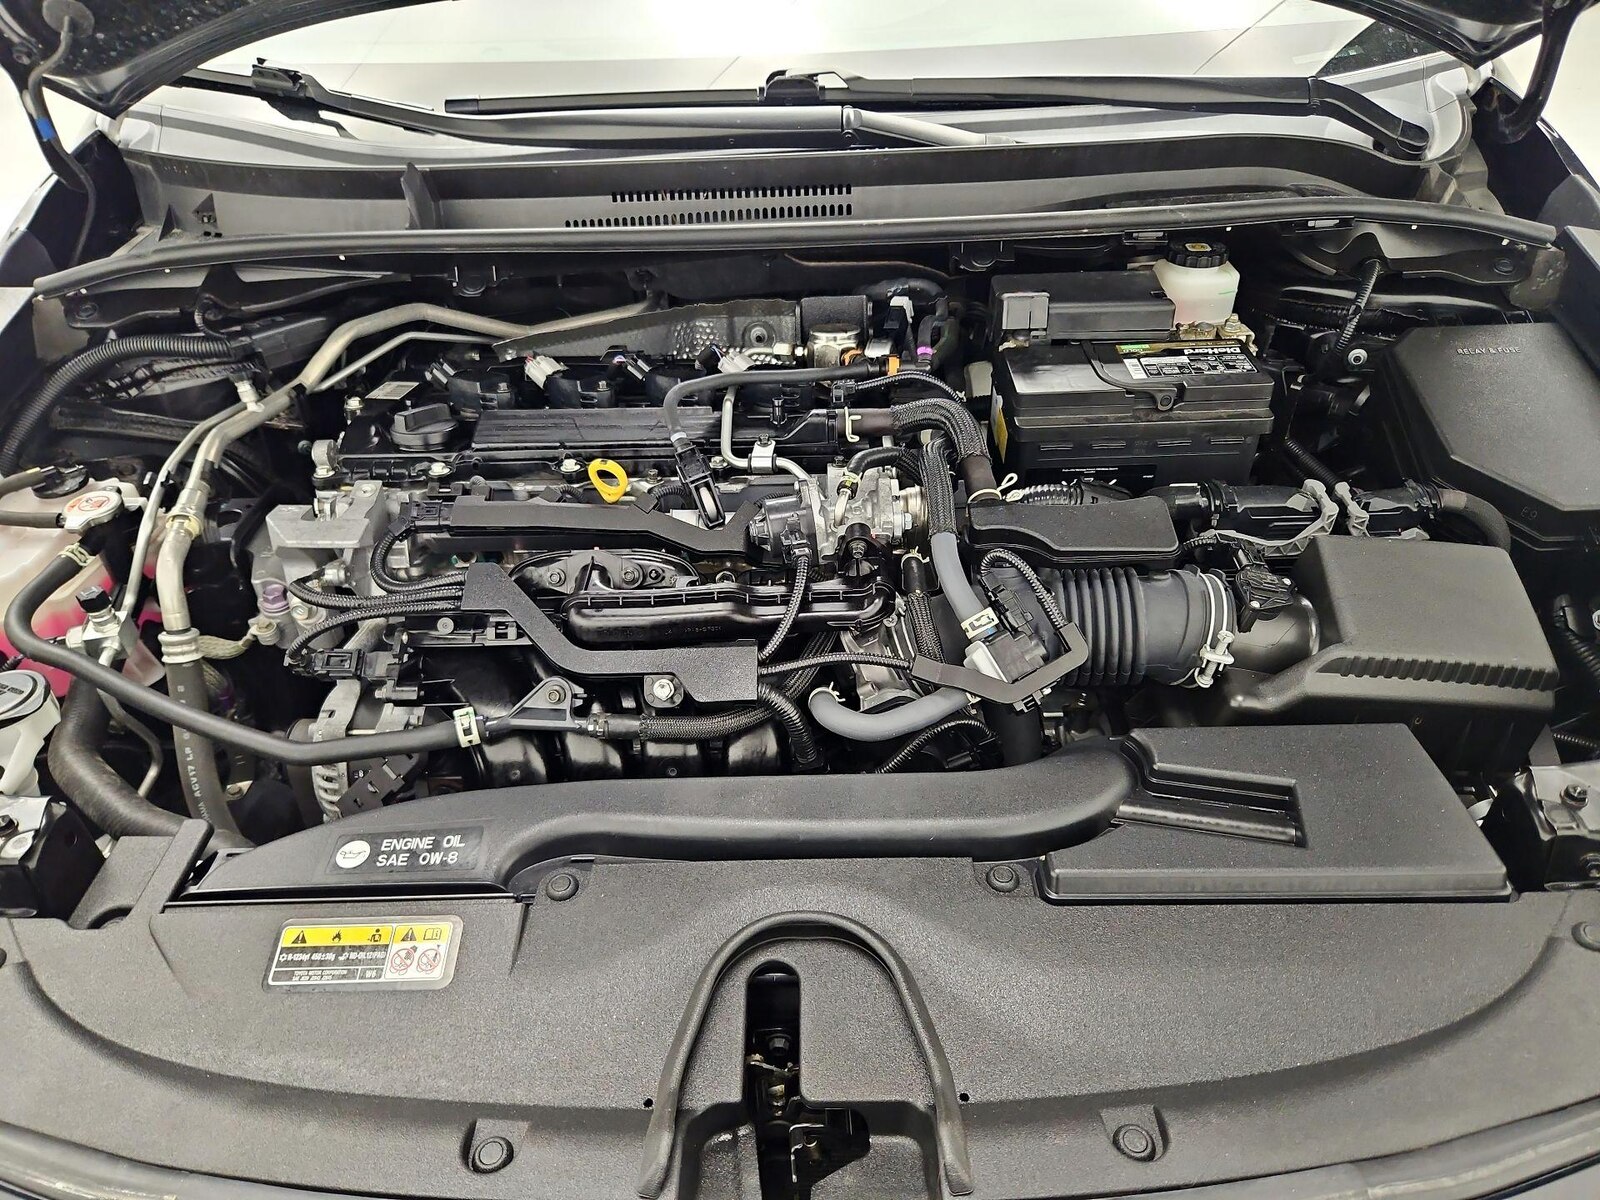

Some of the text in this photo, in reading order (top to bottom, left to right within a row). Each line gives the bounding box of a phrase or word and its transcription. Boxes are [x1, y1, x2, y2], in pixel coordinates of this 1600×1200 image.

[1184, 347, 1241, 355] DieHard
[1456, 347, 1485, 355] RELAY
[1497, 346, 1521, 354] FUSE
[380, 834, 465, 851] ENGINE OIL
[376, 853, 409, 867] SAE
